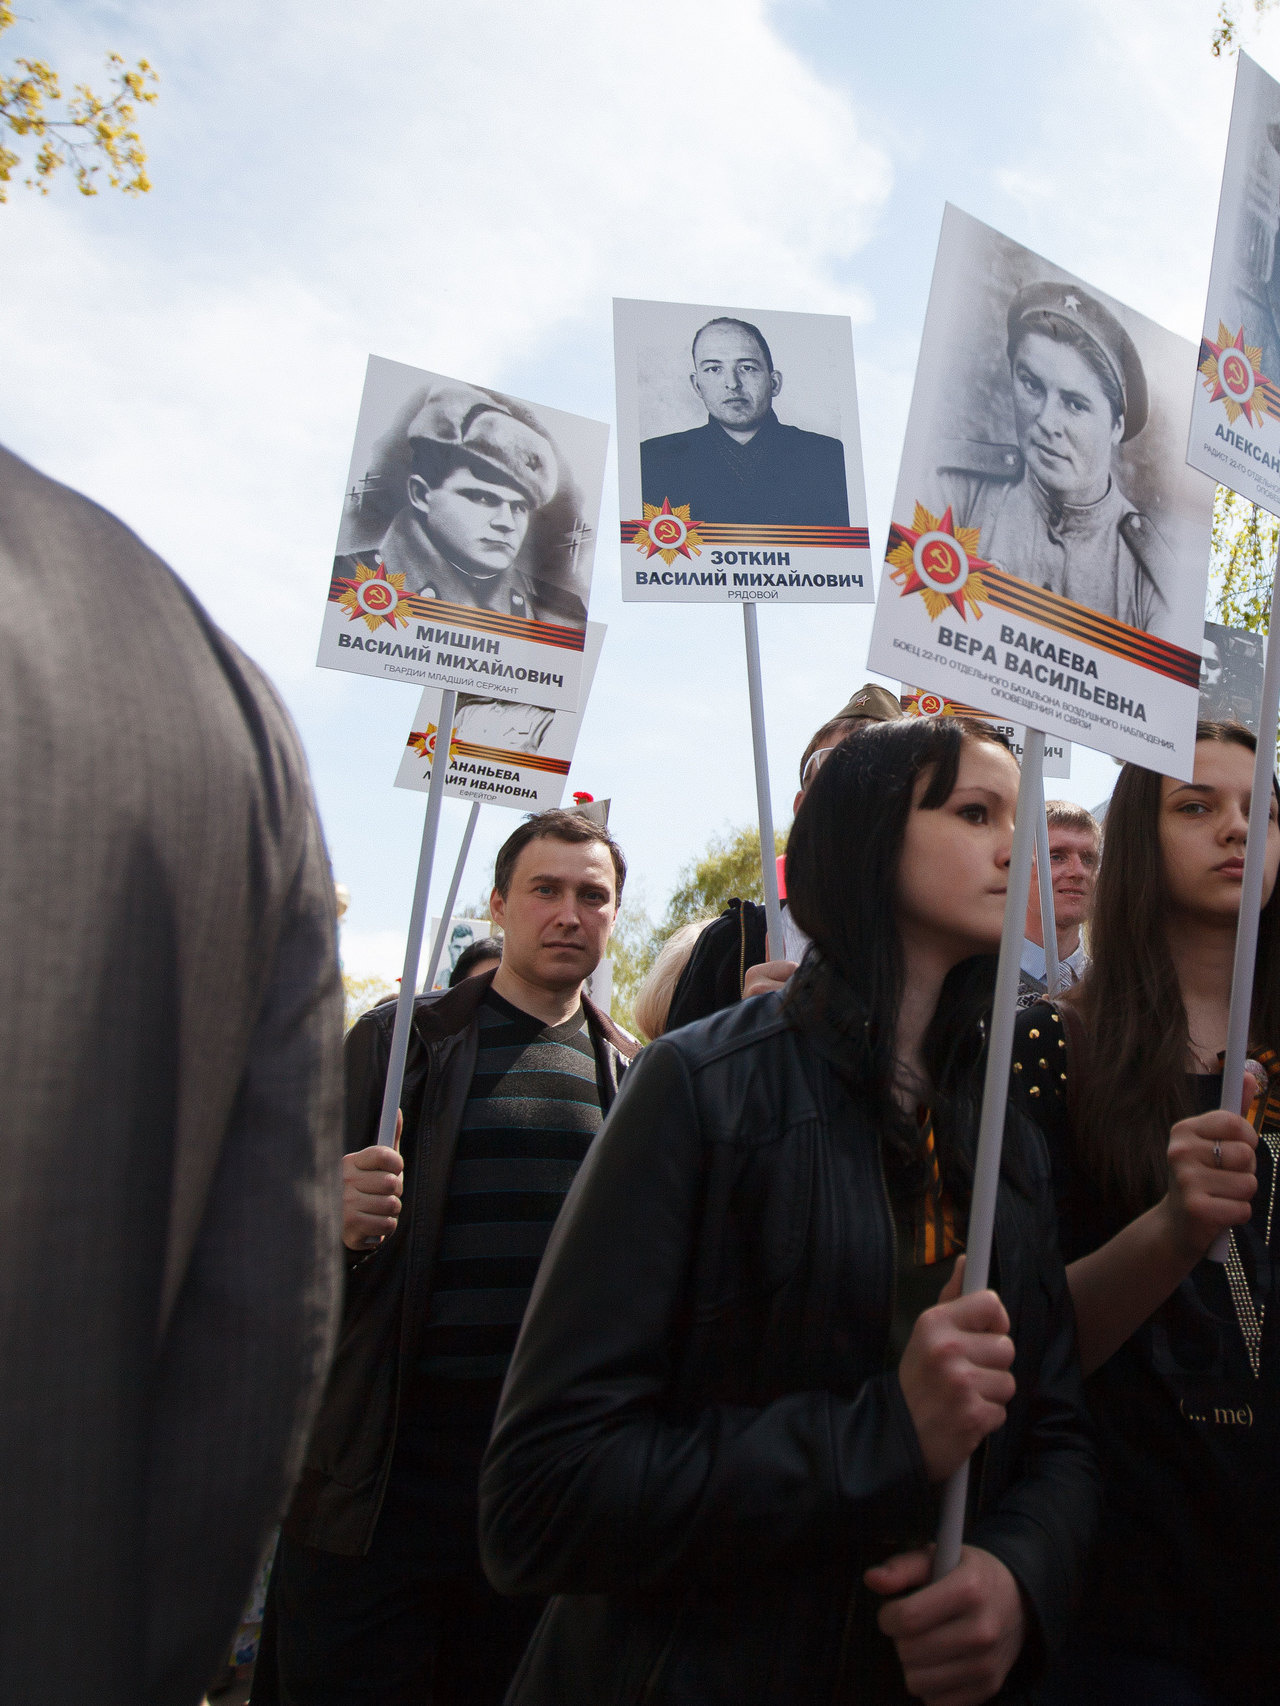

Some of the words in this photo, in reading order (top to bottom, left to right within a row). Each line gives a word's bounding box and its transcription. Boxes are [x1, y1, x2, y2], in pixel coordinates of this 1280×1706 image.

[711, 551, 790, 566] ЗОТКИН
[636, 569, 727, 586] ВАСИЛИЙ
[733, 570, 864, 587] МИХАЙЛОВИЧ
[728, 589, 779, 600] РЯДОВОЙ
[416, 625, 500, 655] МИШИН
[999, 625, 1099, 679] ВАКАЕВА
[338, 634, 431, 663] ВАСИЛИЙ
[436, 652, 564, 687] МИХАЙЛОВИЧ
[938, 626, 997, 665] ВЕРА
[1005, 652, 1147, 722] ВАСИЛЬЕВНА
[384, 664, 426, 678] ГВАРДИИ
[428, 671, 474, 687] МЛАДШИЙ
[476, 680, 518, 695] СЕРЖАНТ
[892, 638, 921, 657] БОЕЦ
[920, 648, 948, 666] 22-ГО
[949, 660, 1010, 688] ОТДЕЛЬНОГО
[1010, 681, 1062, 709] БАТАЛЬОНА
[1062, 700, 1119, 730] ВОЗДУШНОГО
[991, 686, 1054, 718] ОПОВЕЩЕНИЯ
[1054, 711, 1062, 720] И
[1063, 714, 1092, 731] СВЯЗИ
[423, 771, 467, 786] ЛИЯ
[470, 779, 538, 799] ИВАНОВНА
[449, 761, 520, 782] АНАНЬЕВА
[459, 790, 497, 801] ЕФРЕЙТОР
